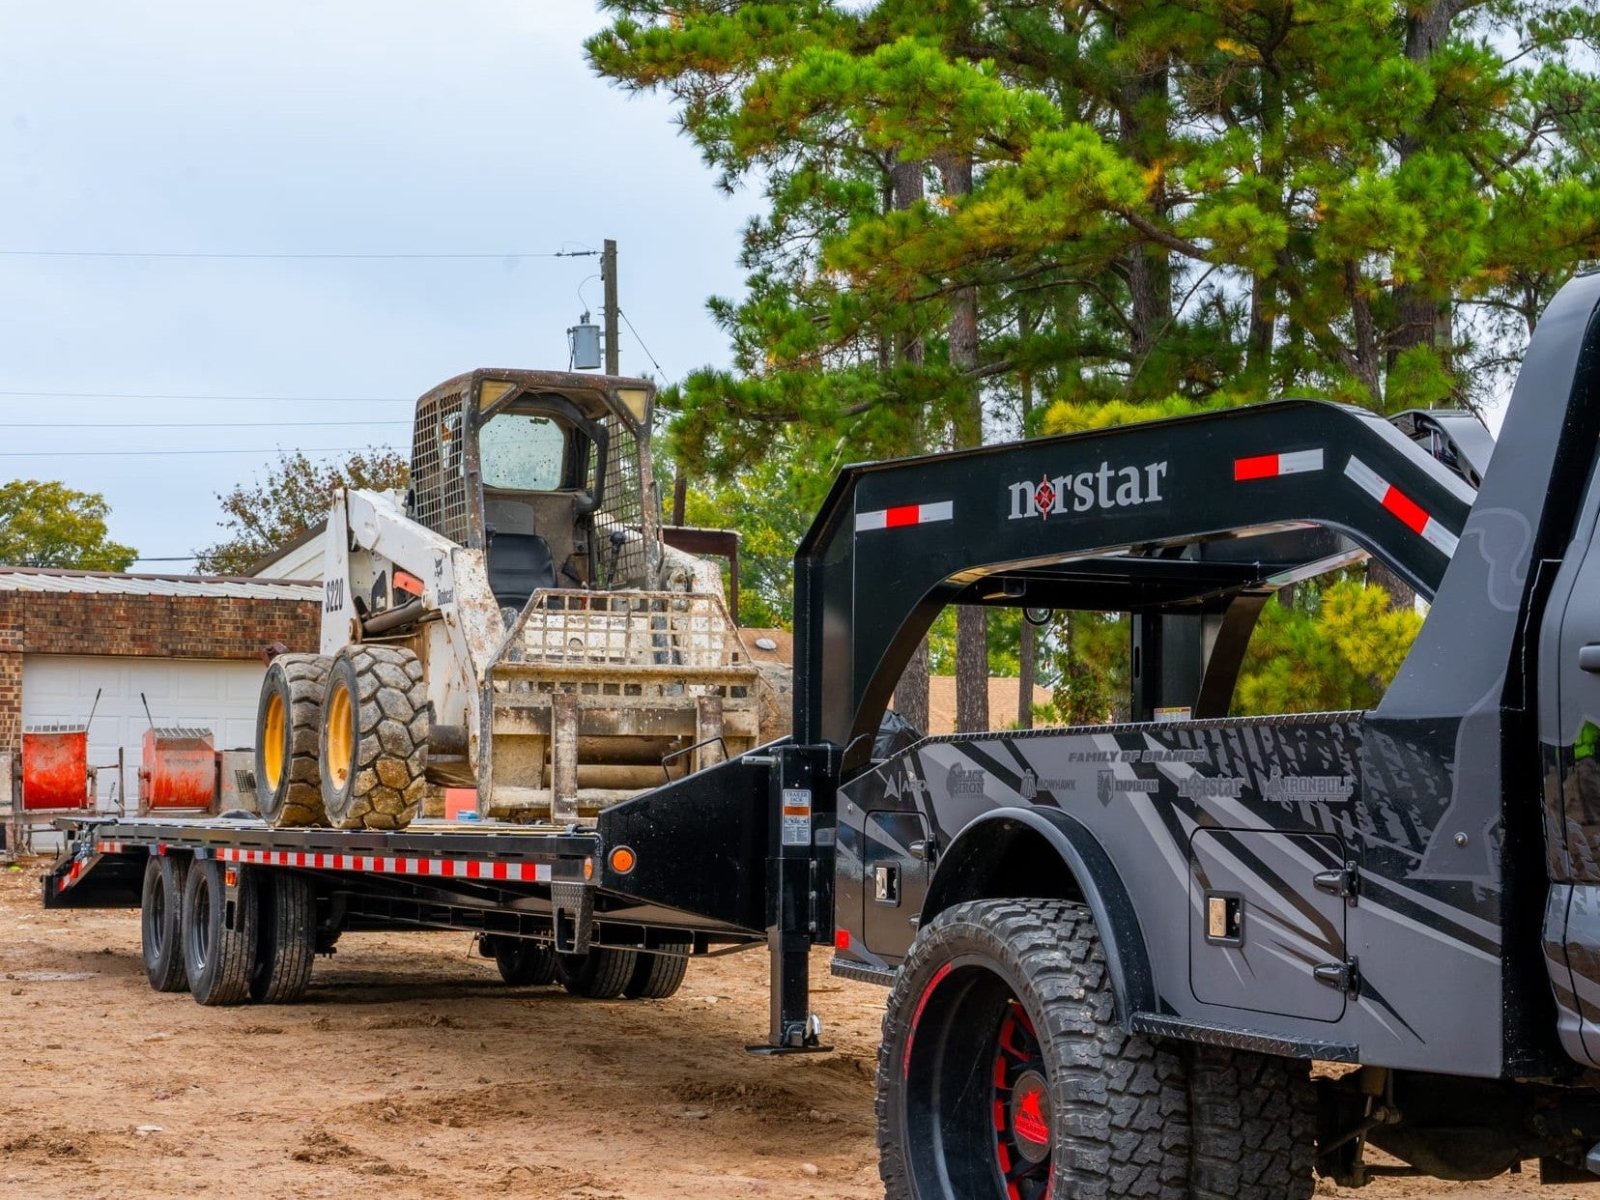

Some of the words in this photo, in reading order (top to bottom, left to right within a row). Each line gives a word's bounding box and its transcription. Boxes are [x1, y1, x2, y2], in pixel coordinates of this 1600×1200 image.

[1008, 460, 1168, 520] norstar
[326, 577, 344, 613] S220
[1068, 751, 1119, 763] FAMILY
[1121, 750, 1141, 763] OF
[1141, 750, 1205, 763] BRANDS
[1284, 776, 1353, 793] IRONBULL
